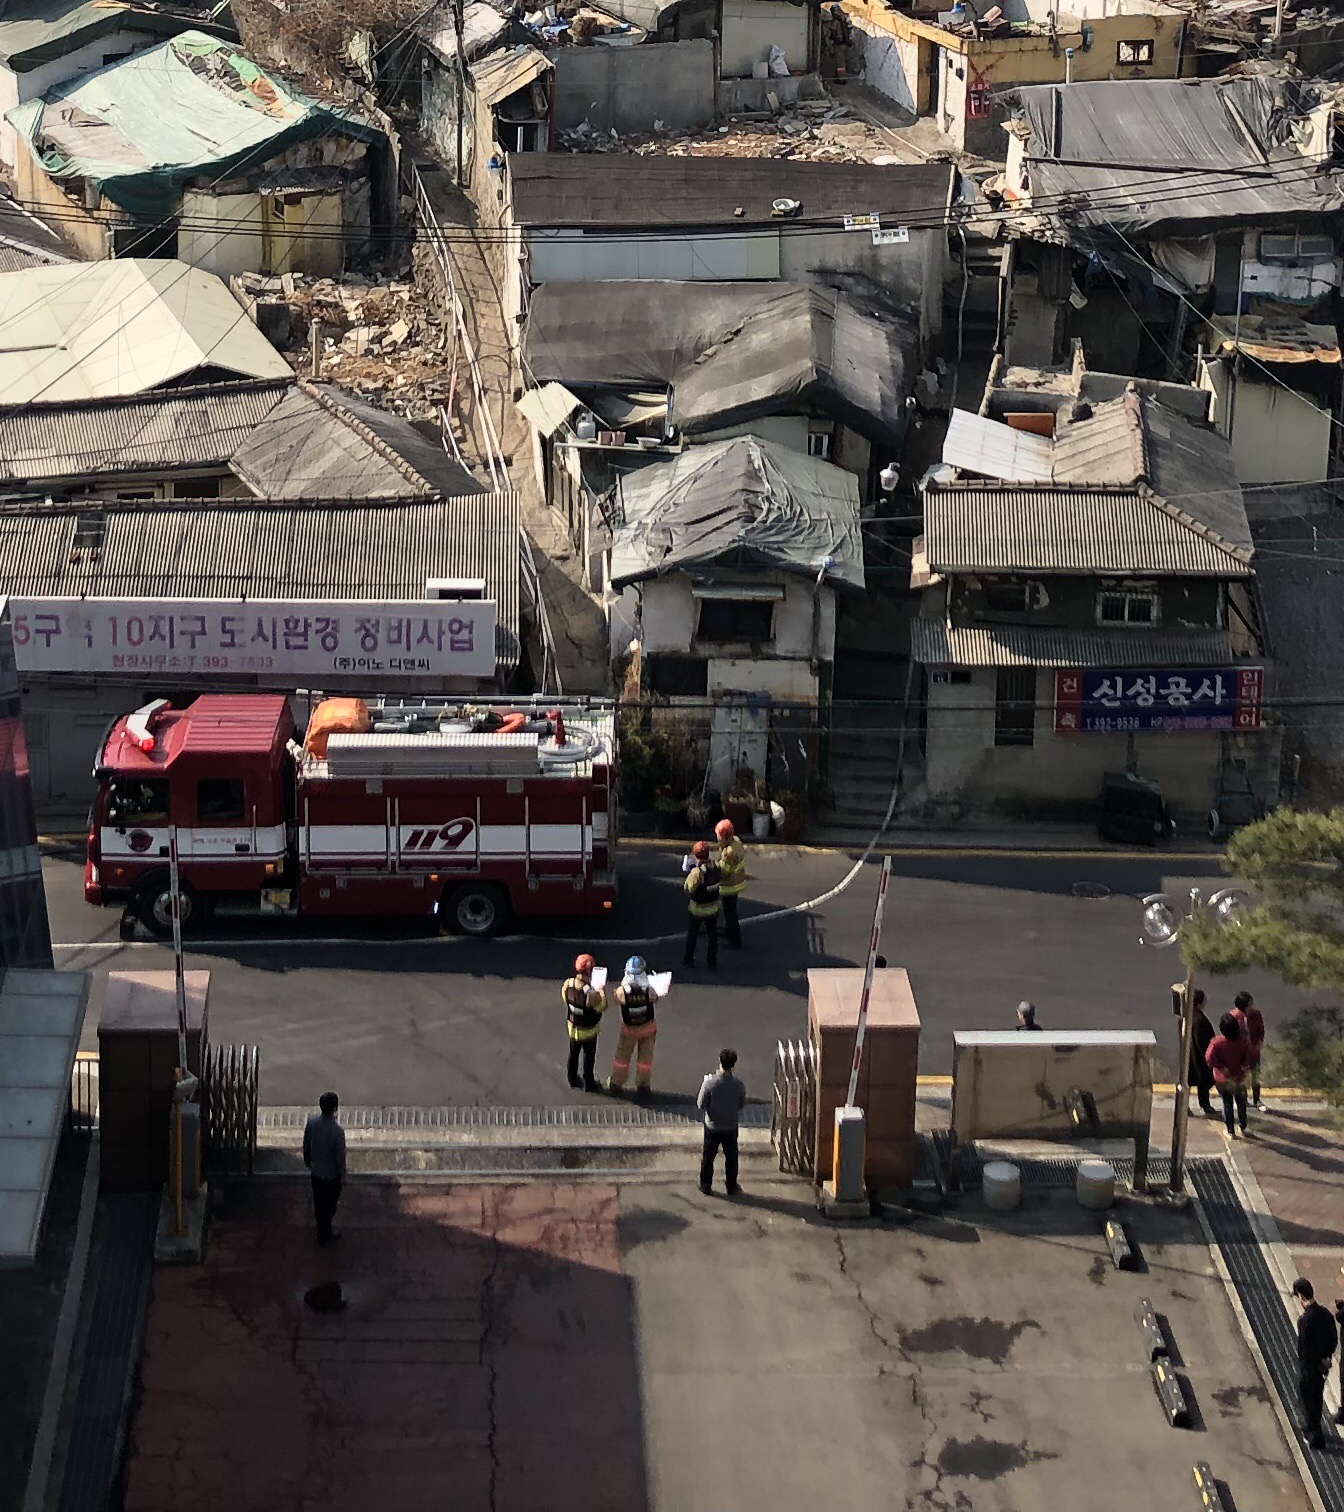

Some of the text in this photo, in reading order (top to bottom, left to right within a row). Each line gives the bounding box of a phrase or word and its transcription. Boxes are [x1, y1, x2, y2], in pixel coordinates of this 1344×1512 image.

[108, 615, 207, 649] 10지구
[220, 615, 341, 652] 도시환경
[354, 616, 474, 652] 정비사업
[1092, 674, 1227, 707] 신성공사
[403, 817, 476, 850] 119
